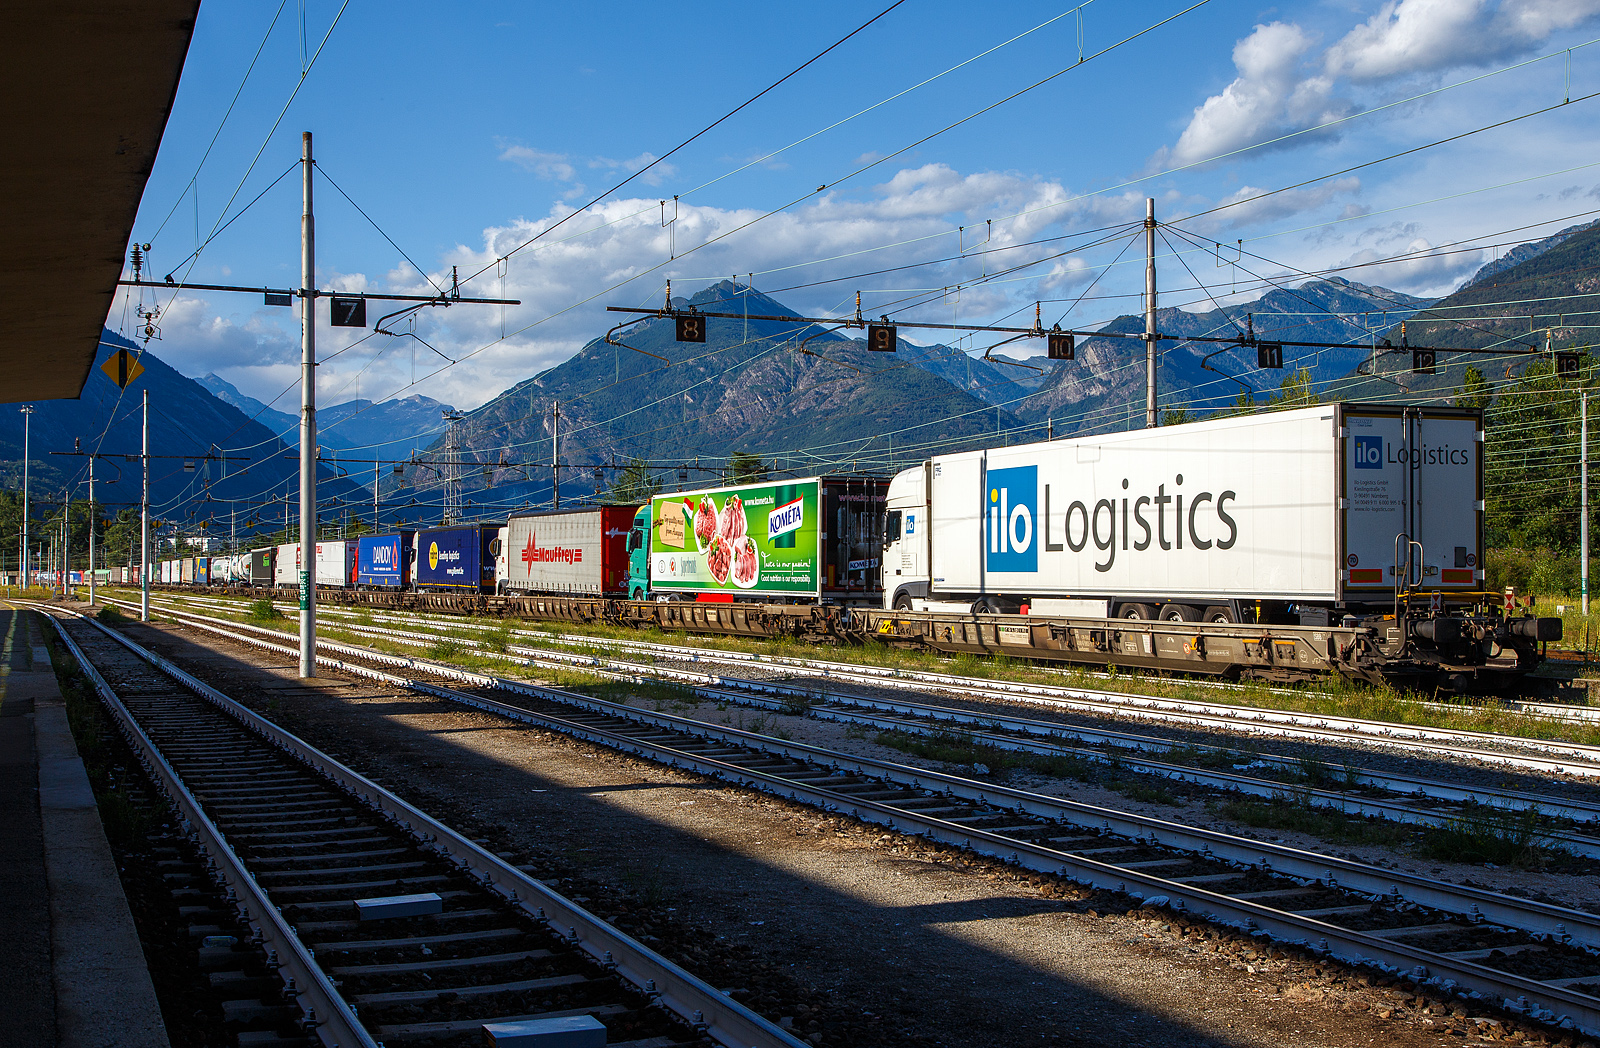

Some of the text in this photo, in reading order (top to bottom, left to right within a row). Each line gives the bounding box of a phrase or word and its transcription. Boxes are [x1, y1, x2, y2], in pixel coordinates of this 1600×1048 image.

[340, 302, 358, 323] 7
[684, 319, 698, 338] 8
[876, 329, 889, 349] 9
[1053, 339, 1071, 357] 10
[1265, 348, 1279, 366] 11
[1416, 354, 1433, 372] 12
[1561, 358, 1577, 376] 13
[1356, 442, 1469, 469] ilo Logistics
[770, 505, 802, 533] KOMÉTA
[990, 474, 1237, 572] ilo Logistics
[373, 546, 391, 564] DANDOY
[538, 546, 574, 565] Mauffrey
